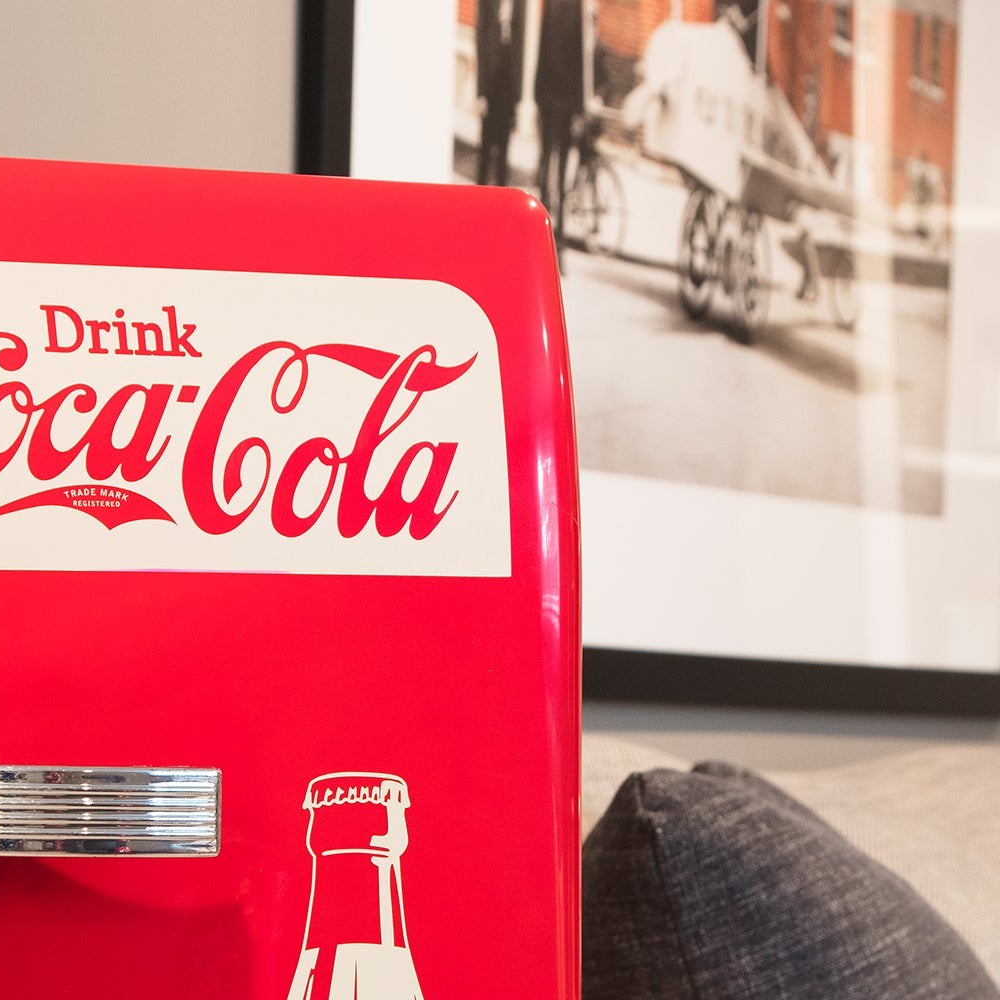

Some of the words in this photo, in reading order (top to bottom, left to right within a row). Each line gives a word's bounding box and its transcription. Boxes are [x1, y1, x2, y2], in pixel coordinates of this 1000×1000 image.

[39, 304, 202, 358] Drink
[63, 487, 97, 499] TRADE
[100, 488, 129, 502] MARK
[72, 499, 121, 508] REGISTERED
